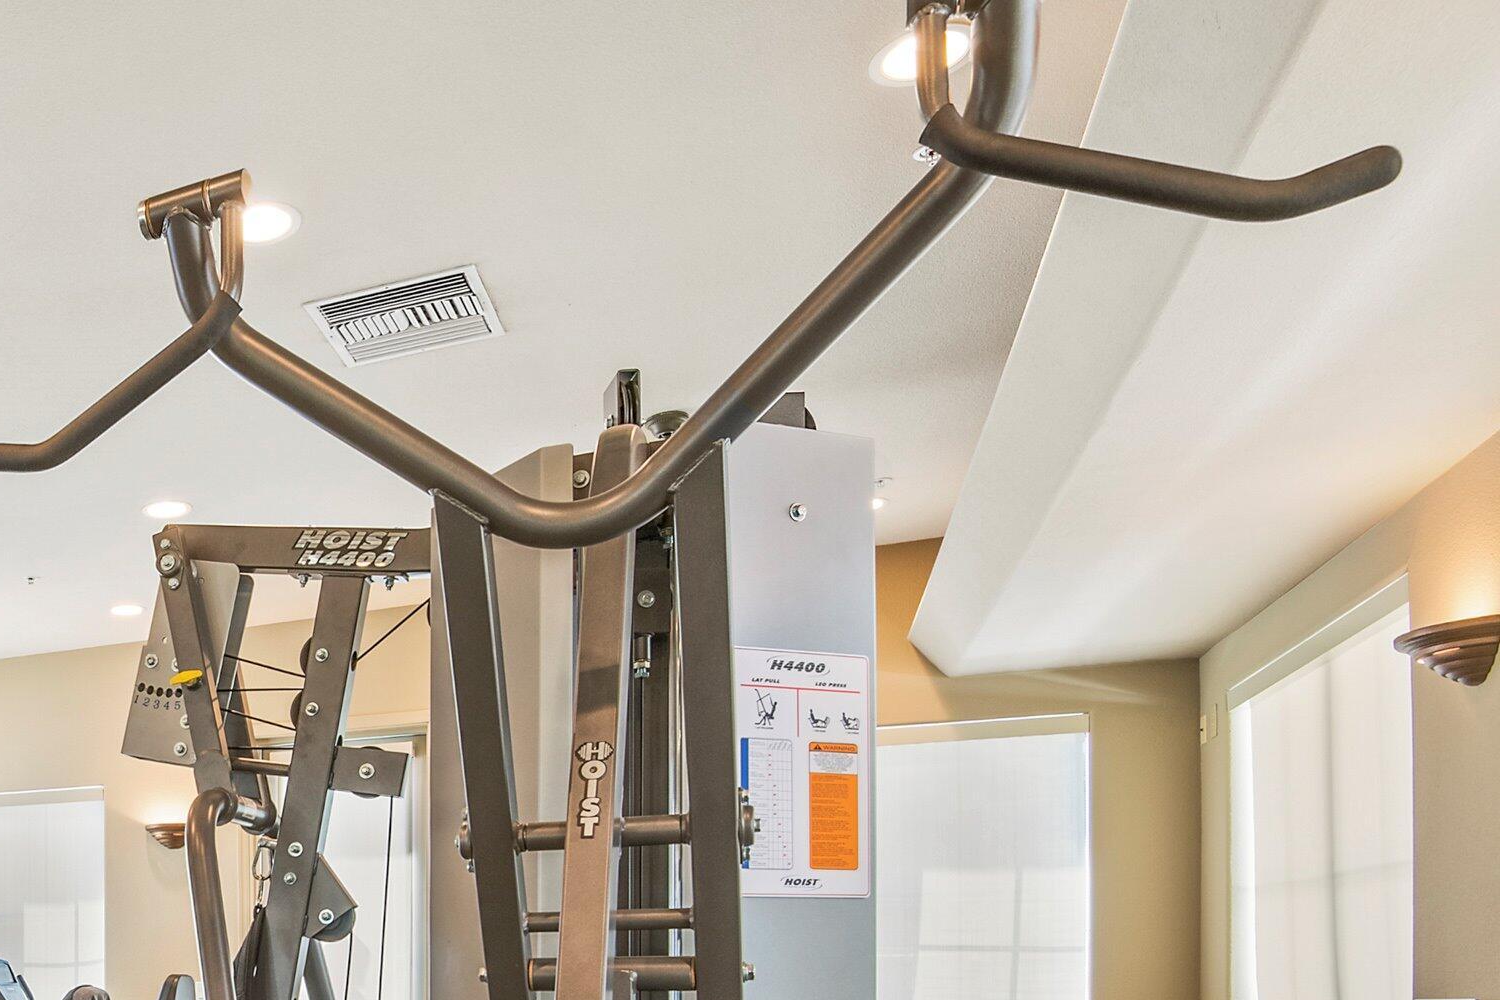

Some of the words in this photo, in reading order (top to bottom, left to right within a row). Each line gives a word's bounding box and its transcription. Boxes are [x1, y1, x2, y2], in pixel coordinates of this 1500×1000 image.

[292, 529, 409, 551] HOIST
[296, 550, 396, 568] H4400
[770, 659, 826, 674] H4400
[135, 695, 139, 703] 1
[142, 697, 150, 707] 2
[153, 699, 160, 710] 3
[164, 701, 169, 710] 4
[174, 701, 180, 710] 5
[574, 740, 615, 839] HOIST
